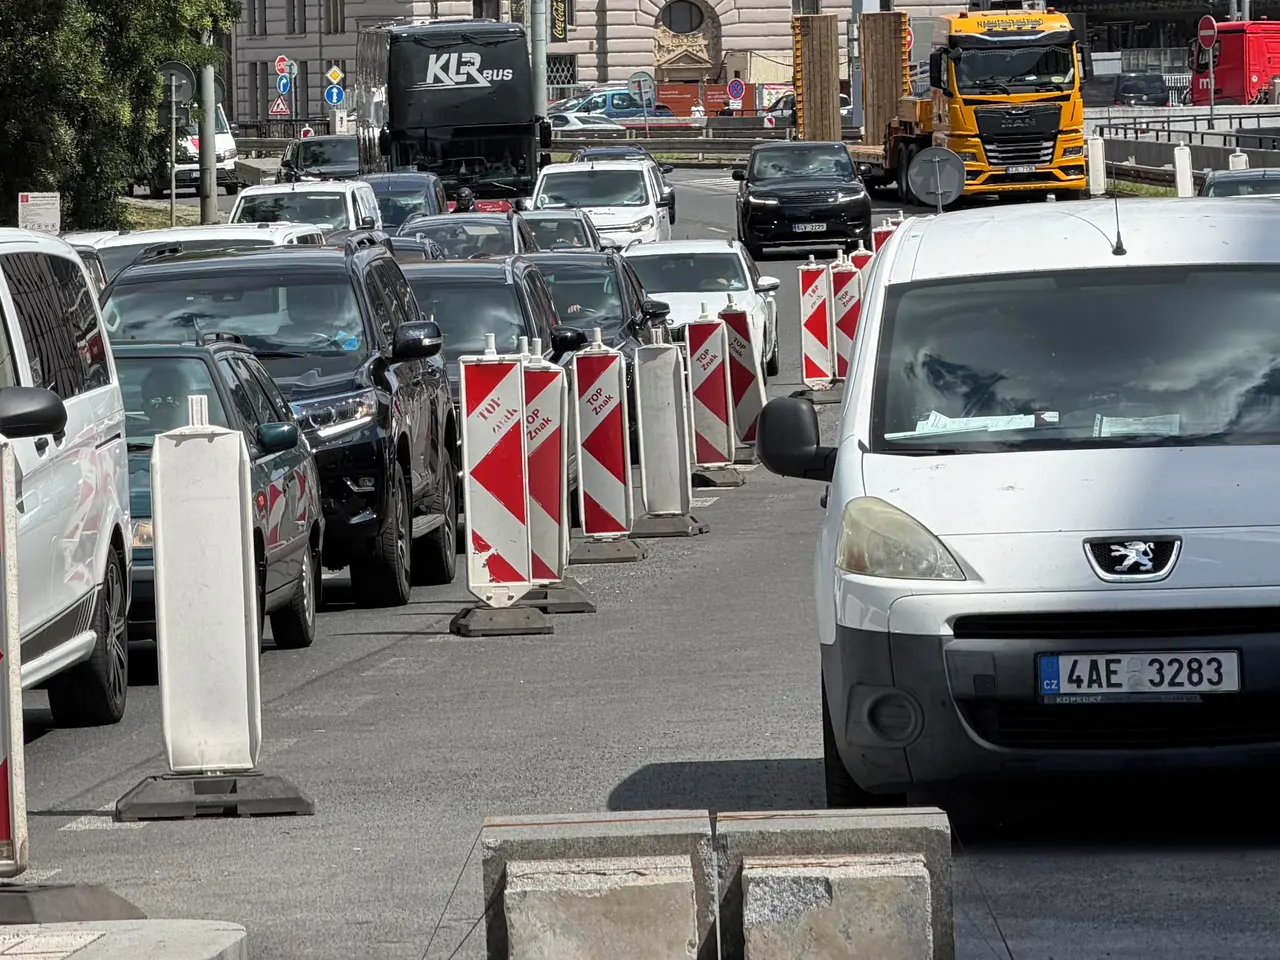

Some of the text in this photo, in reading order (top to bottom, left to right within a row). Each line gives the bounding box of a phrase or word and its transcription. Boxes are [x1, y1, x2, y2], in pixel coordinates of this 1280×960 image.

[425, 52, 513, 87] KLR BUS
[838, 290, 849, 302] TOP
[842, 295, 856, 308] Znak
[728, 342, 743, 357] Znak
[734, 337, 746, 350] TOP
[696, 348, 709, 363] TOP
[701, 354, 718, 371] Znak
[586, 387, 603, 405] TOP
[592, 394, 614, 416] Znak
[525, 408, 540, 429] OP
[526, 416, 552, 441] Znak
[1067, 657, 1224, 689] 4AE 3283
[1043, 680, 1058, 689] CZ
